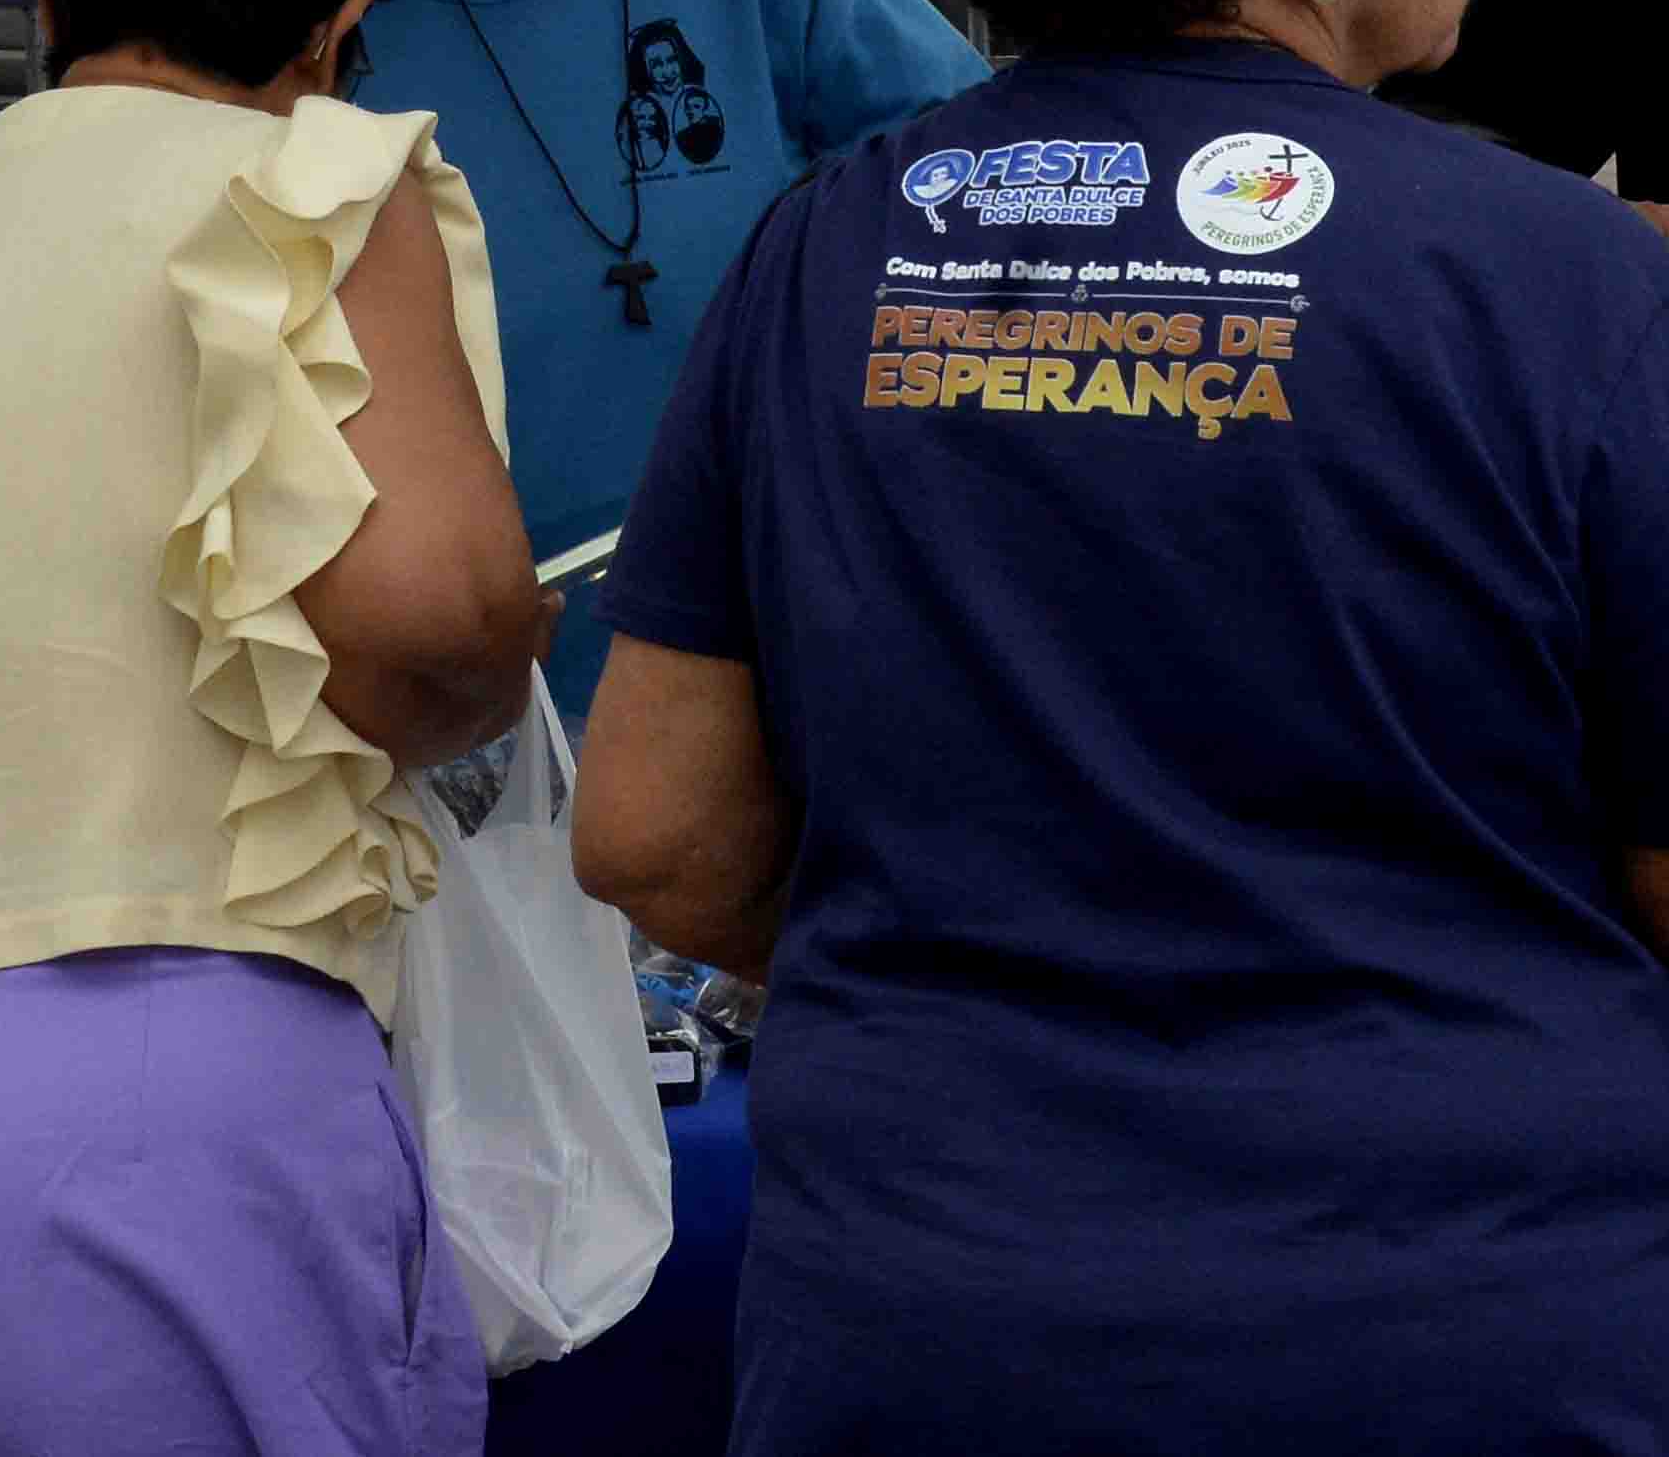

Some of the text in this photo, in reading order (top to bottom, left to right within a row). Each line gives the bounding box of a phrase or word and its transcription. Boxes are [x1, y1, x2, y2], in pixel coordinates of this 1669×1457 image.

[970, 140, 1150, 188] FESTA
[964, 187, 1145, 208] DE SANTA DULCE
[979, 205, 1117, 226] DOS POBRES
[885, 256, 1301, 289] Com Santa Dulce dos Pobres, somos
[871, 304, 1298, 360] PEREGRINOS DE
[863, 351, 1293, 440] ESPERANÇA
